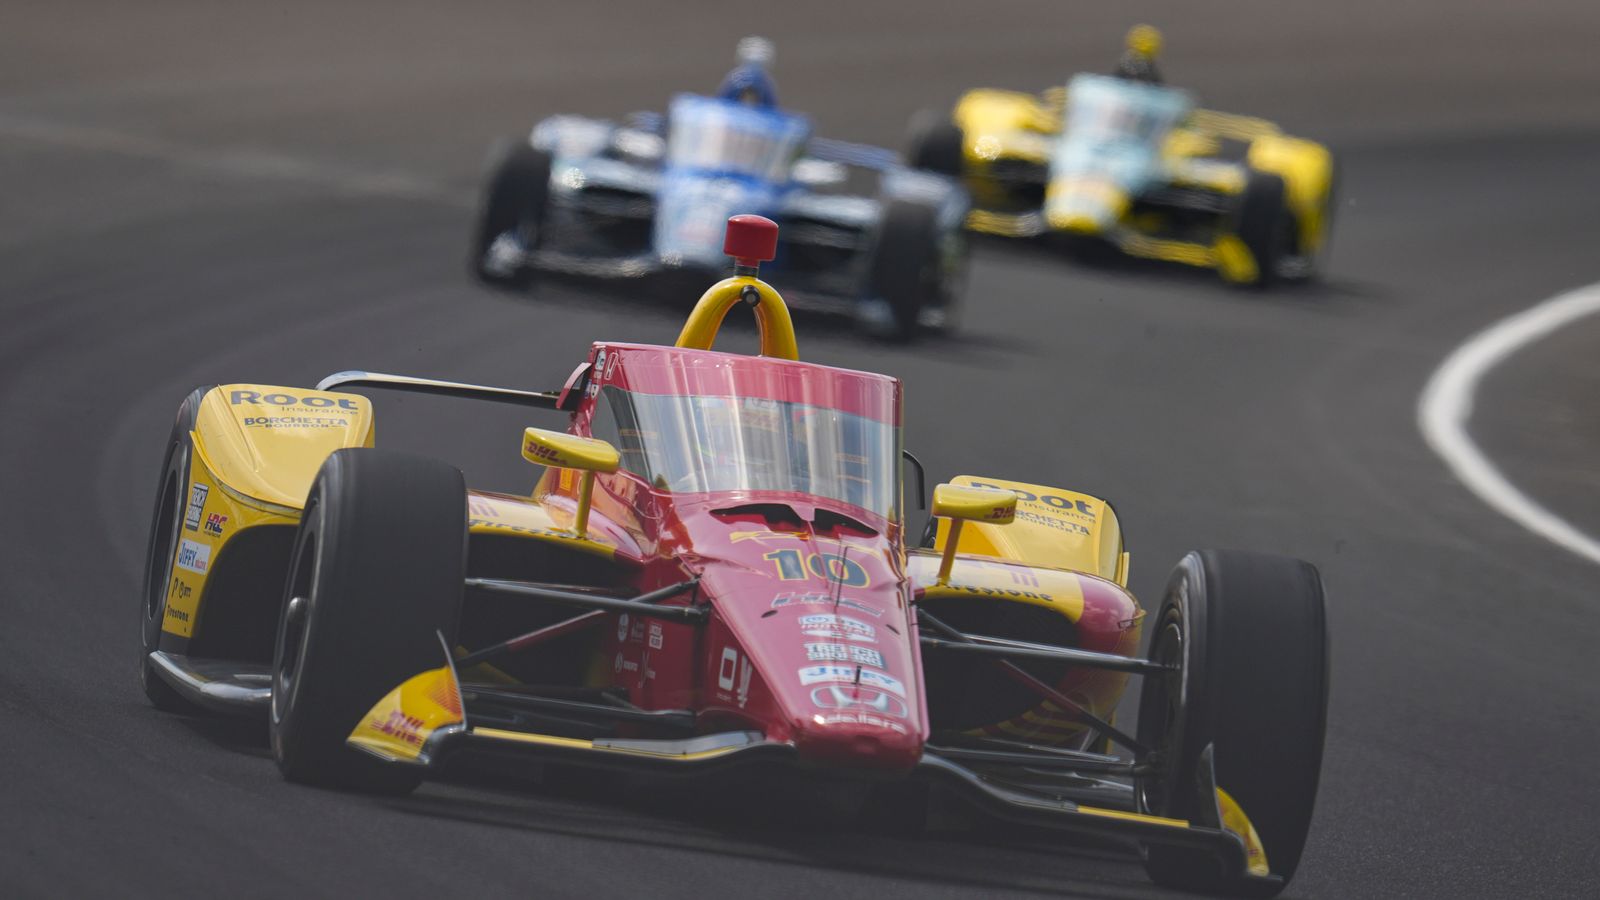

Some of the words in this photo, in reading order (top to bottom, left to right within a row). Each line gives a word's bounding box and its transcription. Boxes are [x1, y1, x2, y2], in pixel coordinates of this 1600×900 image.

[230, 390, 358, 409] Root
[244, 417, 348, 426] BORCHETTA
[526, 441, 559, 462] DHL
[970, 482, 1096, 518] oot
[1015, 509, 1091, 536] RCHETTA
[763, 549, 870, 588] 10
